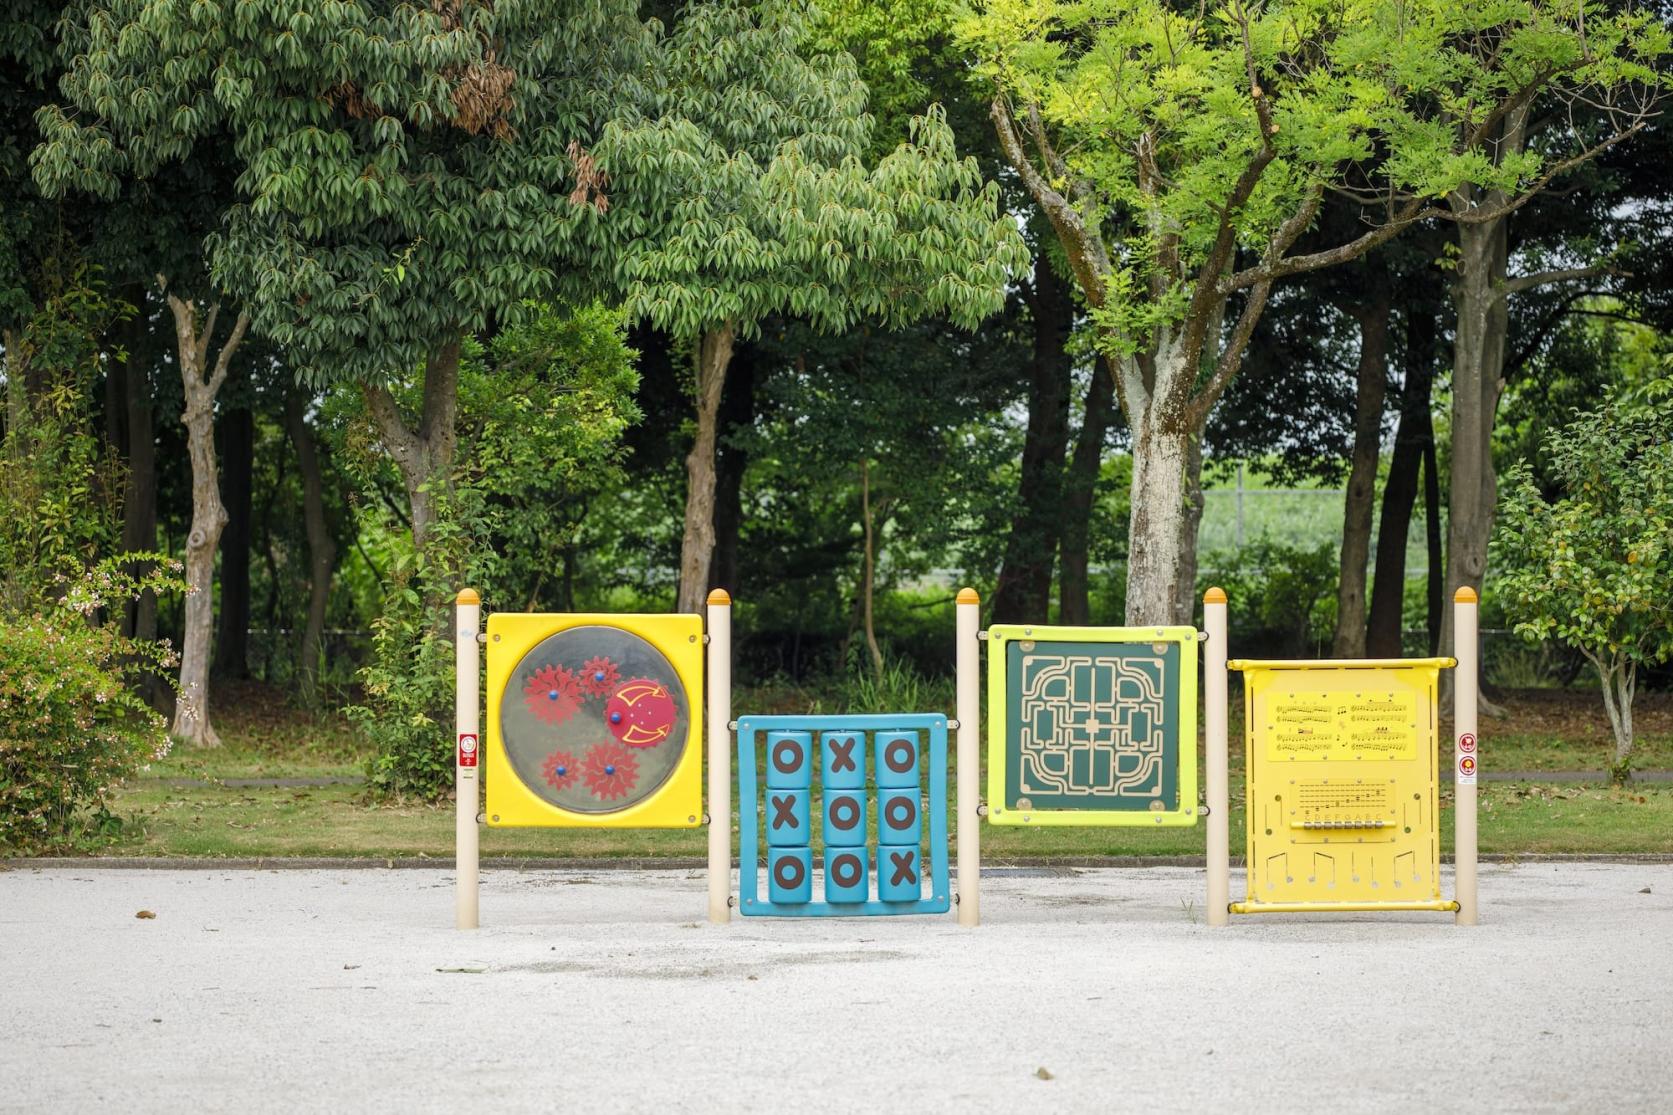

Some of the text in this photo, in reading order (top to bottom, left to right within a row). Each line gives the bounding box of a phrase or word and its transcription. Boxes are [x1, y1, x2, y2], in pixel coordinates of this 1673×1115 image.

[772, 737, 916, 774] O X O
[771, 794, 916, 831] X O O
[773, 851, 917, 890] O O X
